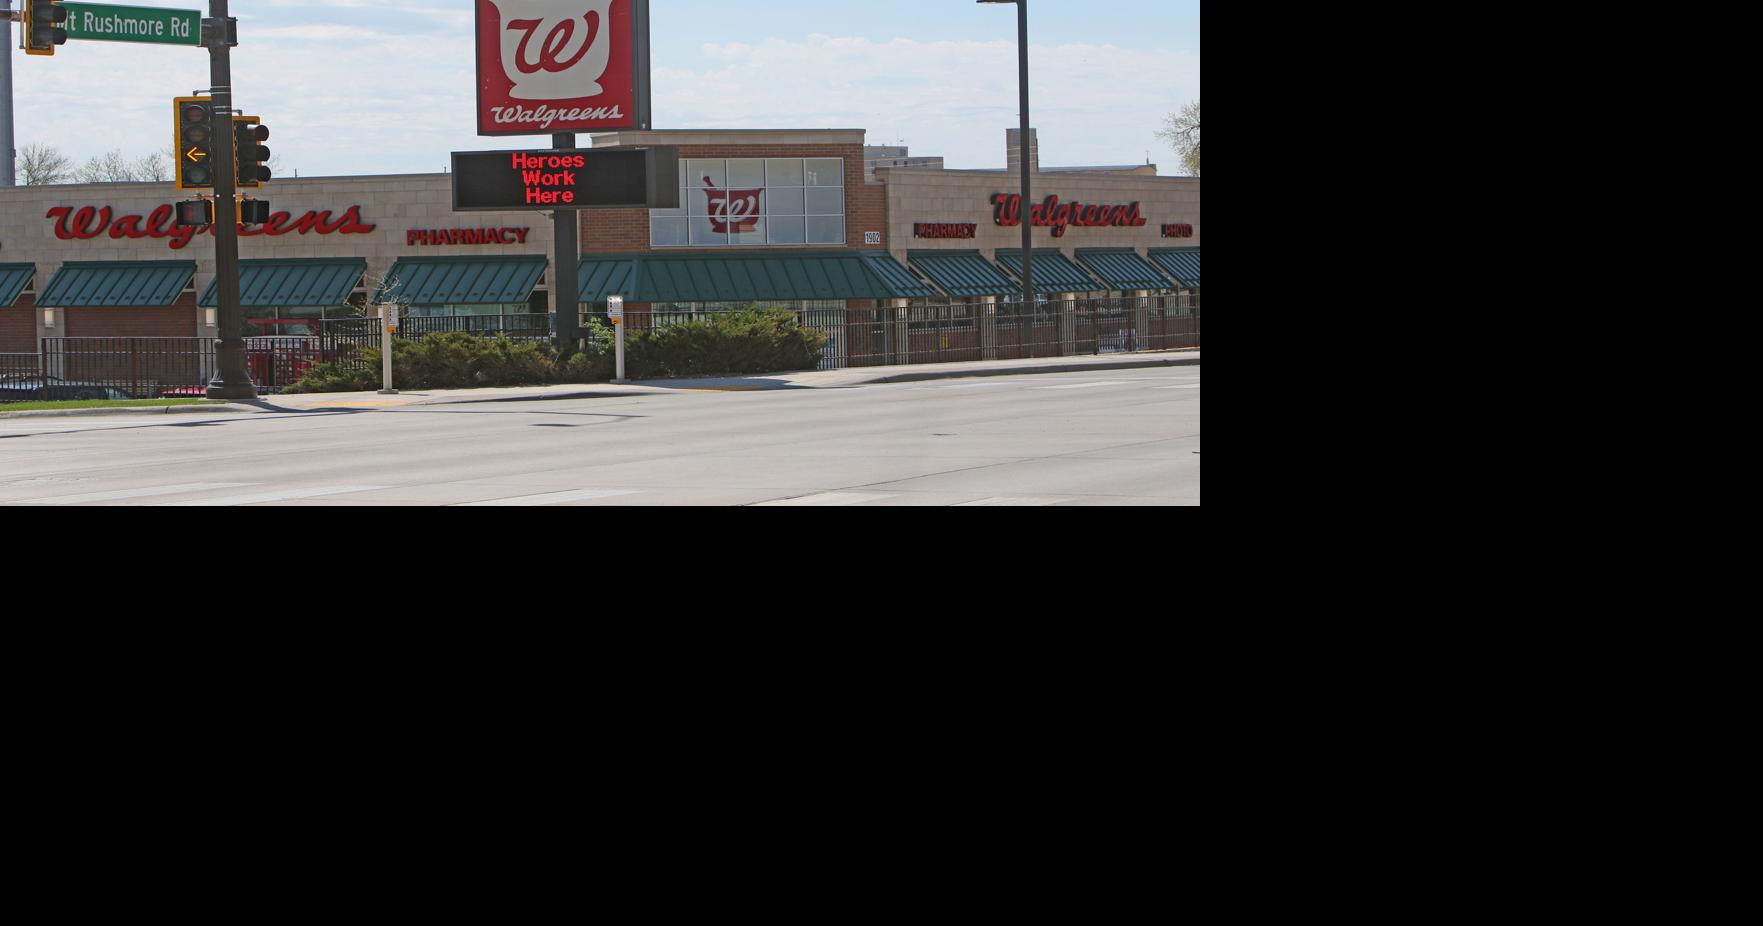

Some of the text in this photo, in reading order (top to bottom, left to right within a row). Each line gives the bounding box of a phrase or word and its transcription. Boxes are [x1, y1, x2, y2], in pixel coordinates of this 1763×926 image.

[84, 11, 164, 36] Rushmore
[171, 17, 190, 38] Rd
[506, 10, 600, 73] W
[490, 104, 624, 129] Walgreens
[512, 152, 585, 169] Heroes
[522, 170, 576, 186] Work
[526, 187, 574, 203] Here
[406, 227, 530, 246] PHARMACY
[916, 223, 977, 239] PHARMACY
[1163, 223, 1193, 237] PHOTO
